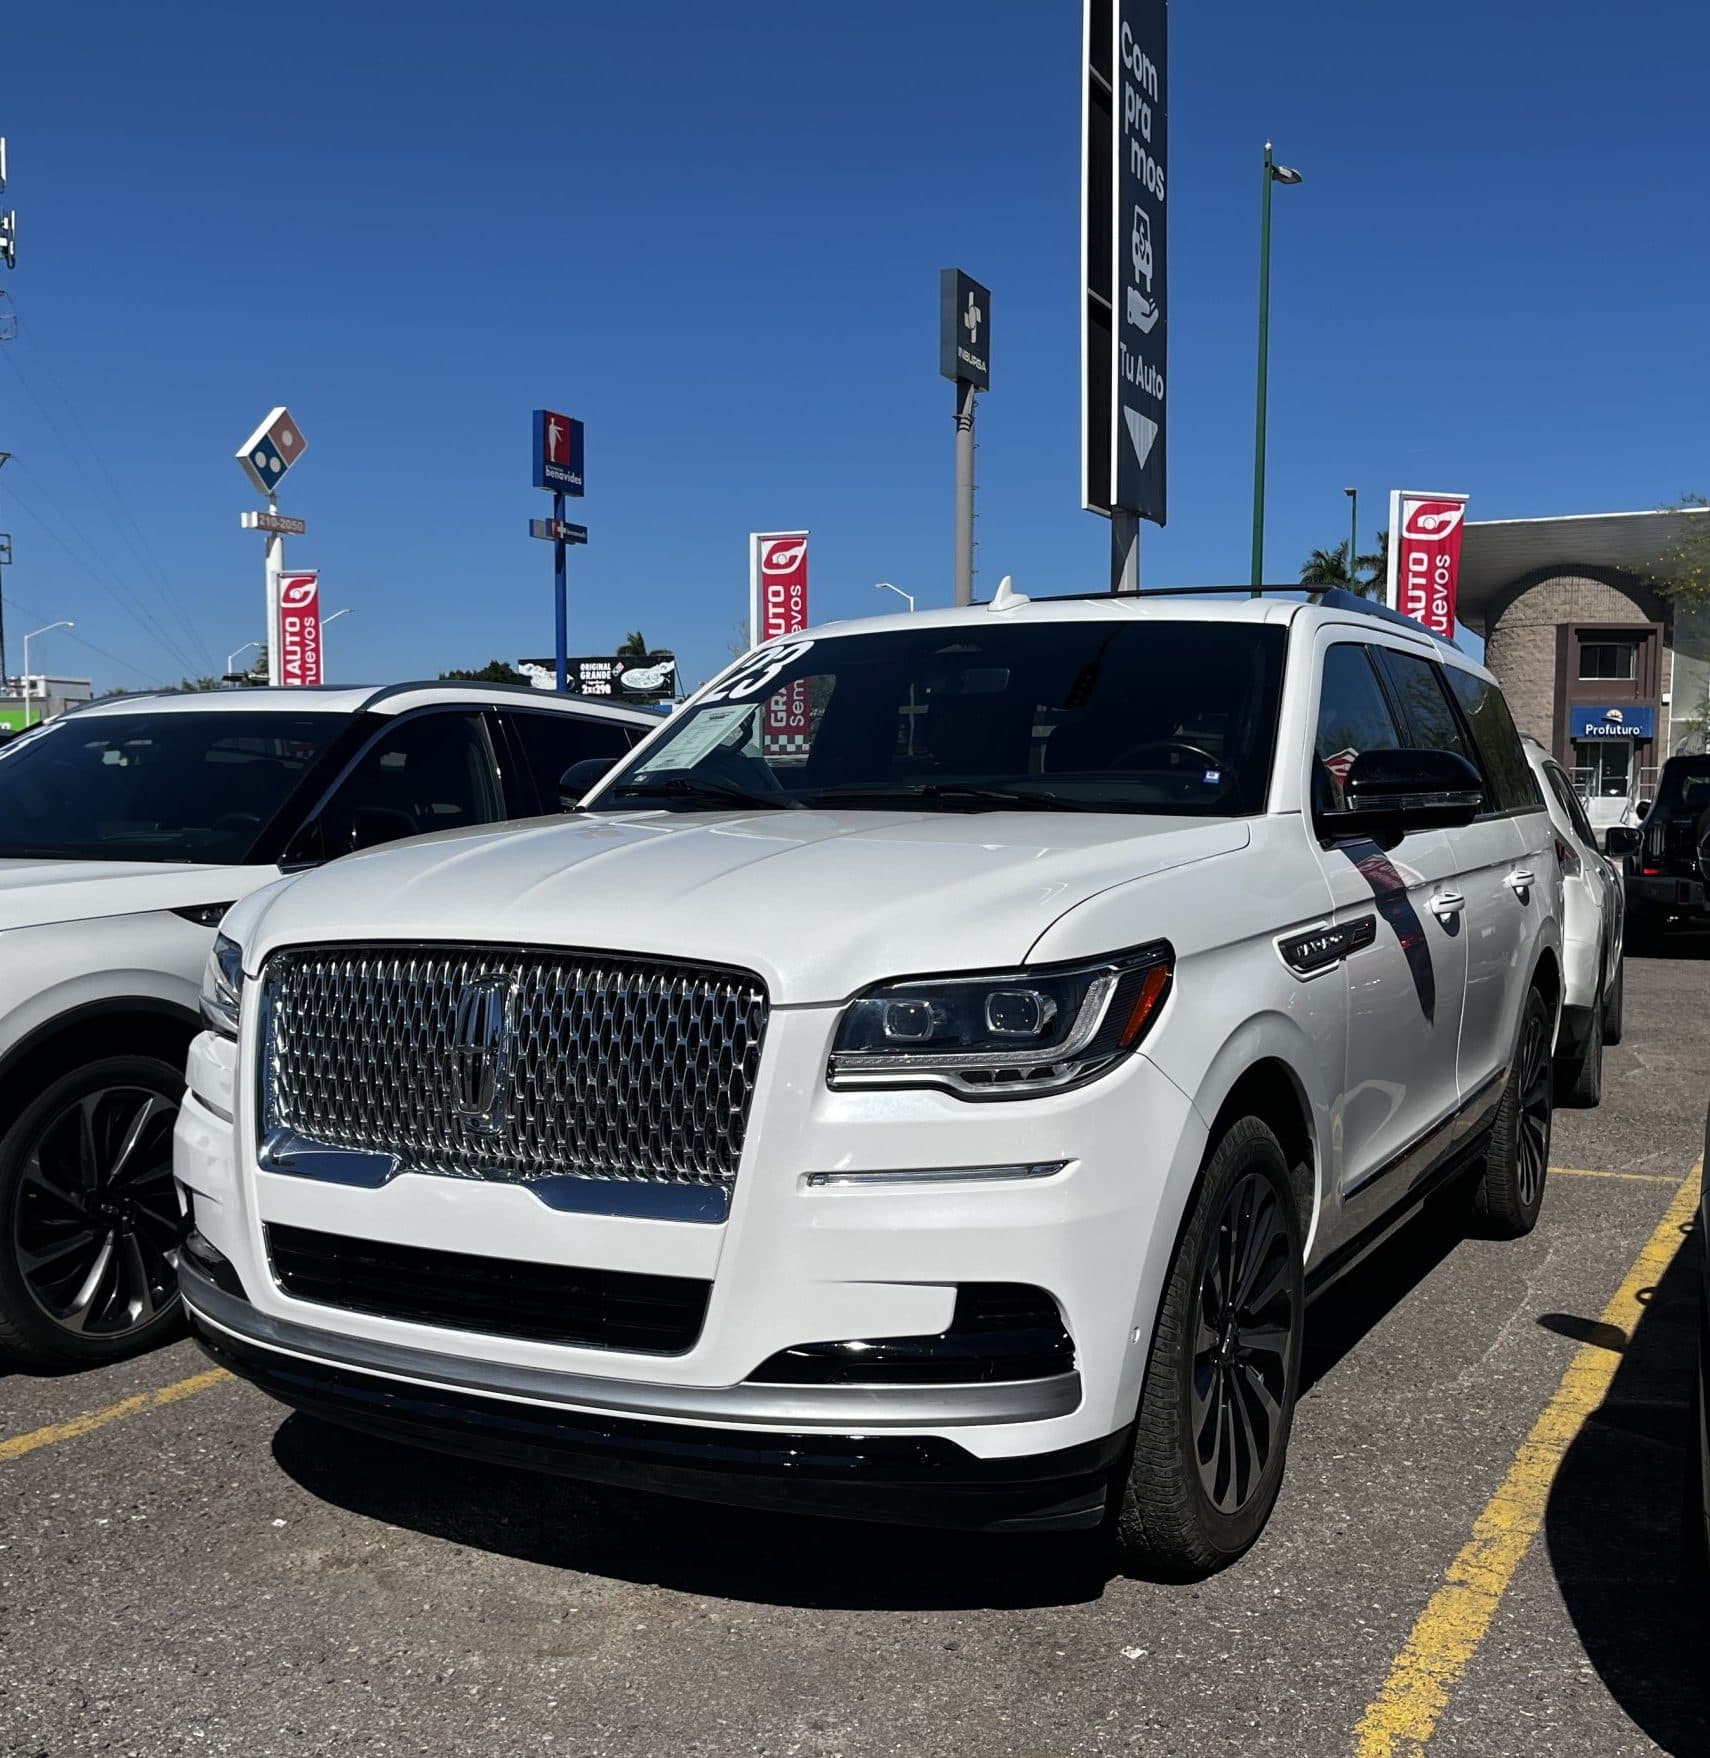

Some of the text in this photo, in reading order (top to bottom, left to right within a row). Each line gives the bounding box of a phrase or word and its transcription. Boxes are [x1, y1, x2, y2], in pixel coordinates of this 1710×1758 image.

[1121, 20, 1159, 103] Com
[1124, 80, 1152, 143] pra
[1131, 137, 1165, 201] mos
[1119, 341, 1165, 400] Tu Auto
[768, 585, 786, 635] UTO
[790, 584, 802, 634] evos
[1431, 554, 1451, 631] uevos
[304, 616, 317, 685] nuevos
[580, 663, 611, 671] ORIGINAL
[580, 671, 611, 680] GRANDE
[790, 680, 804, 727] Sem
[1585, 723, 1641, 736] Profuturo
